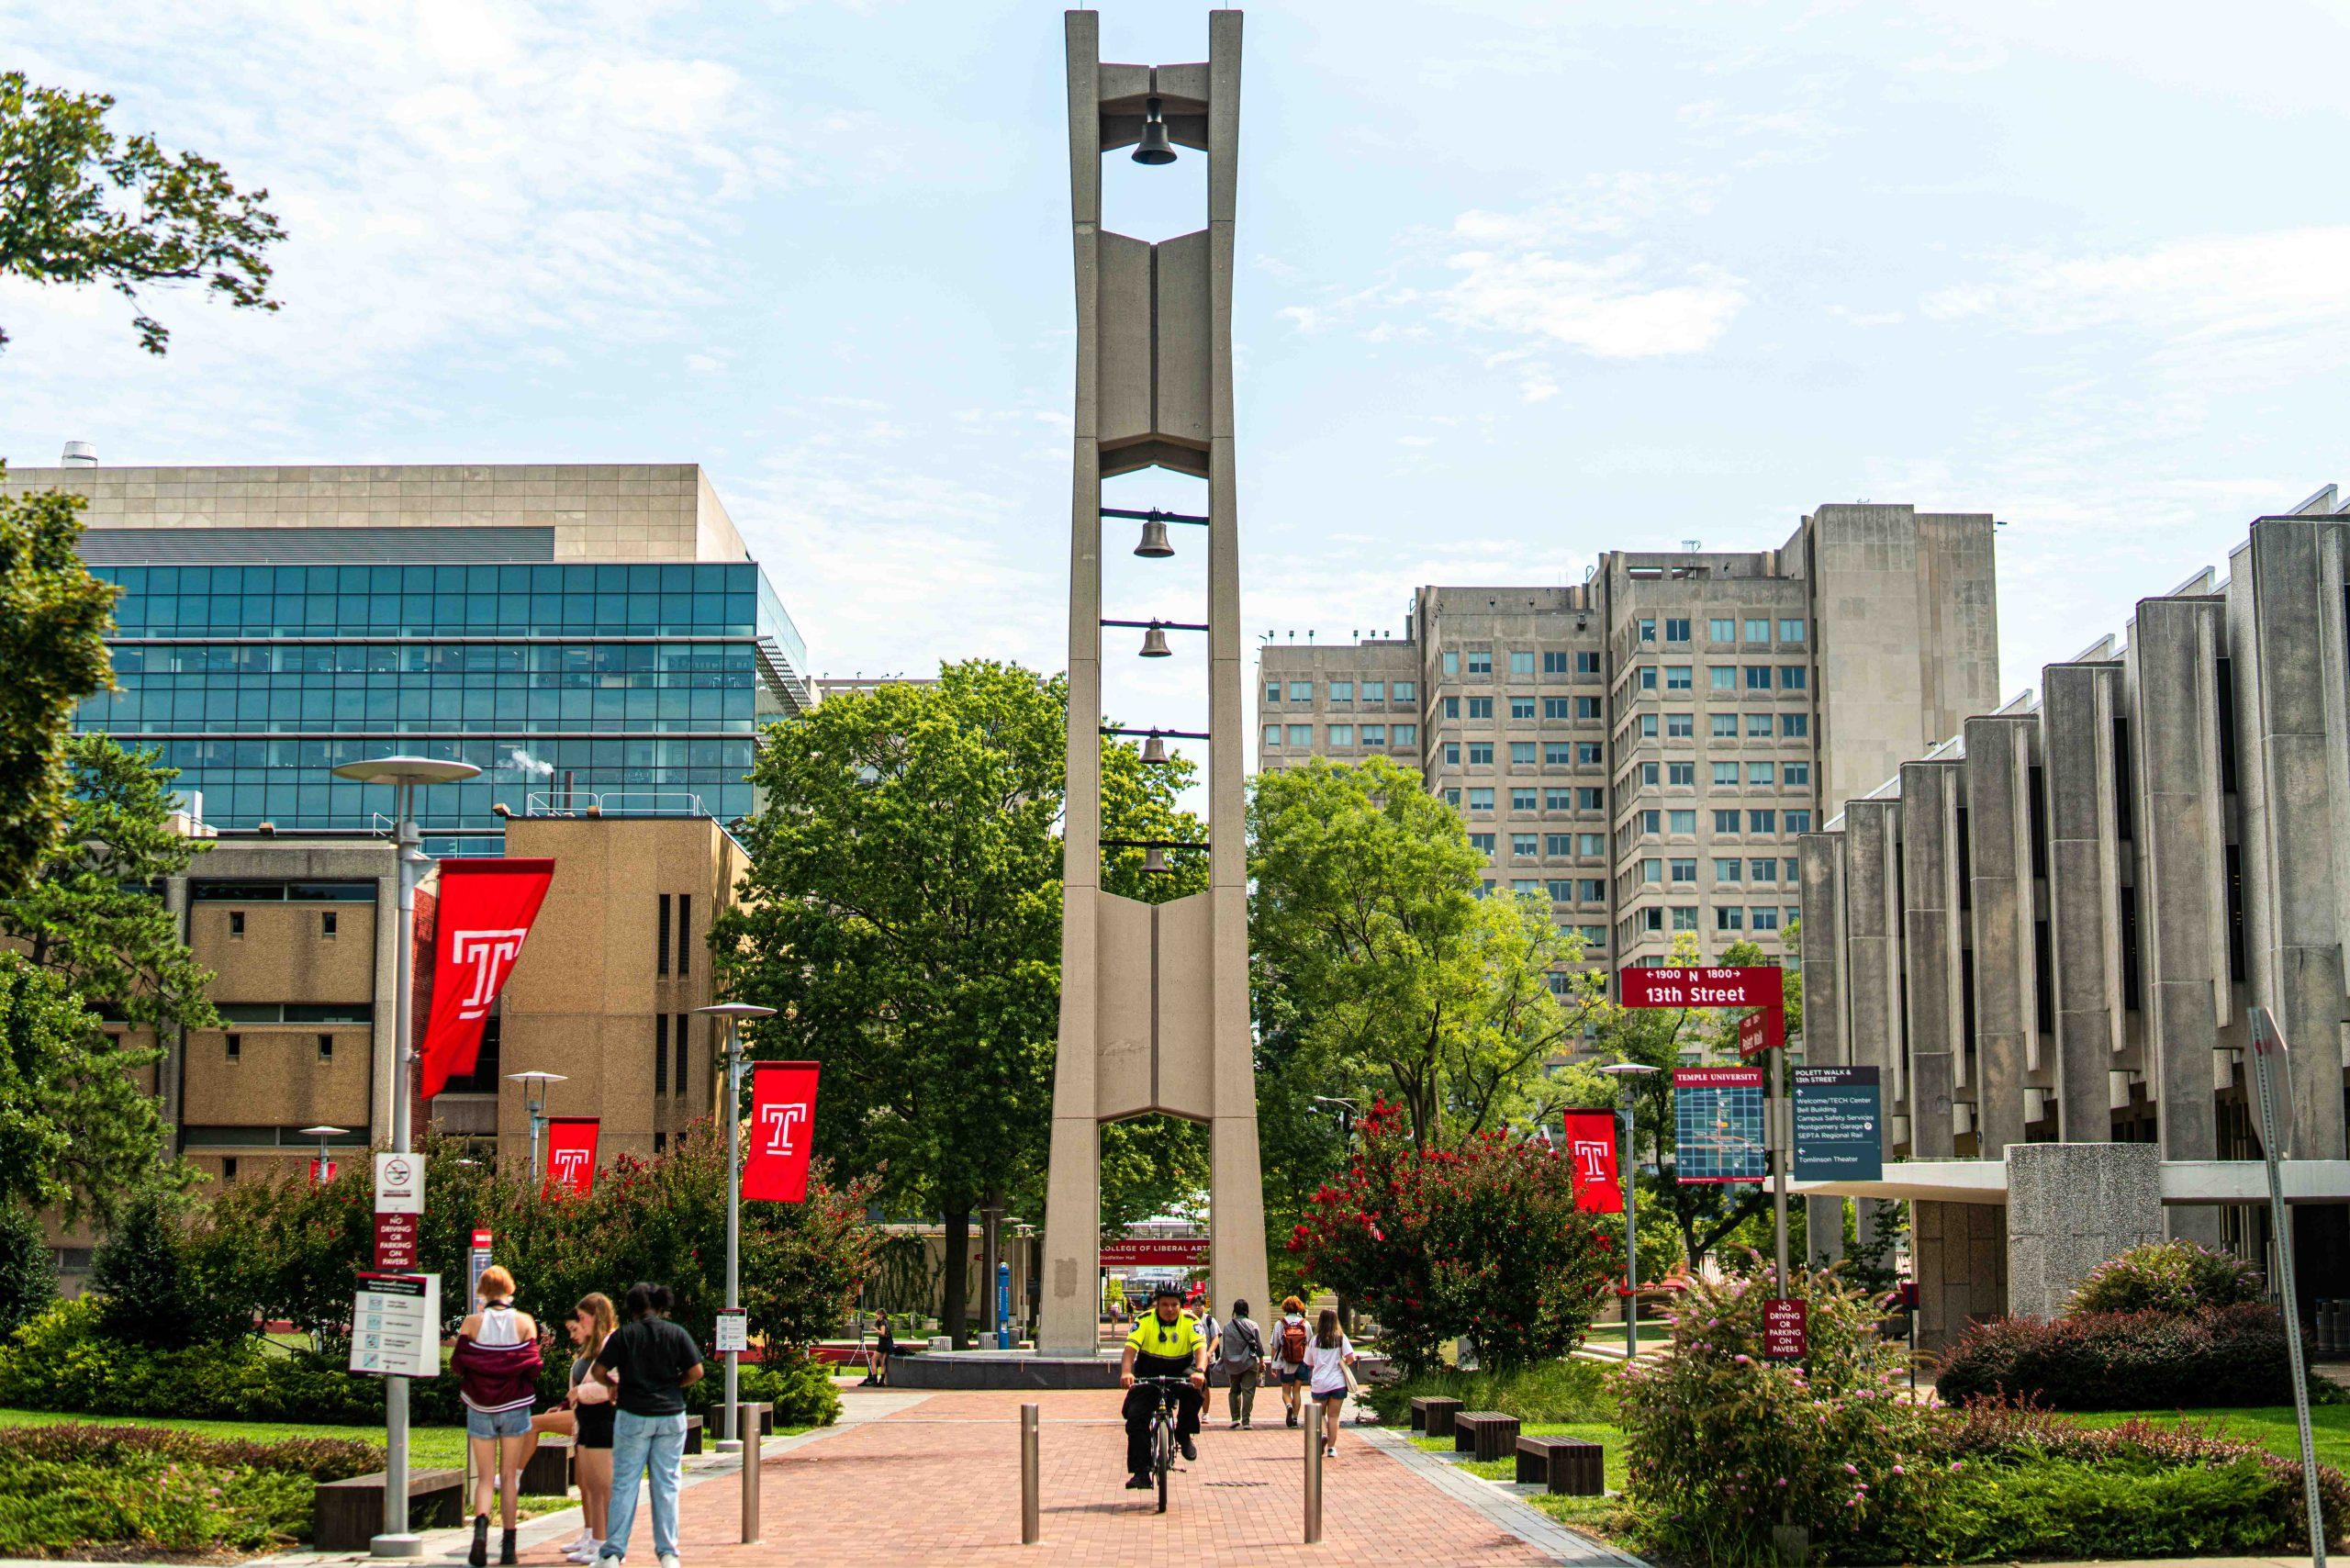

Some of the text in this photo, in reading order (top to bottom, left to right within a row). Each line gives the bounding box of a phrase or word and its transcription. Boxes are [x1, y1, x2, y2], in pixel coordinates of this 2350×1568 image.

[1655, 969, 1732, 982] 1900 N 1800
[1646, 986, 1746, 1002] 13th Street
[1676, 1073, 1708, 1081] TEMPLE
[388, 1249, 403, 1258] ON
[382, 1258, 409, 1266] PAVERS
[1778, 1304, 1792, 1312] NO
[1769, 1312, 1801, 1320] DRIVING
[1779, 1320, 1791, 1328] OR
[1769, 1328, 1801, 1337] PARKING
[1779, 1337, 1792, 1345] ON
[1773, 1345, 1799, 1353] PAVERS
